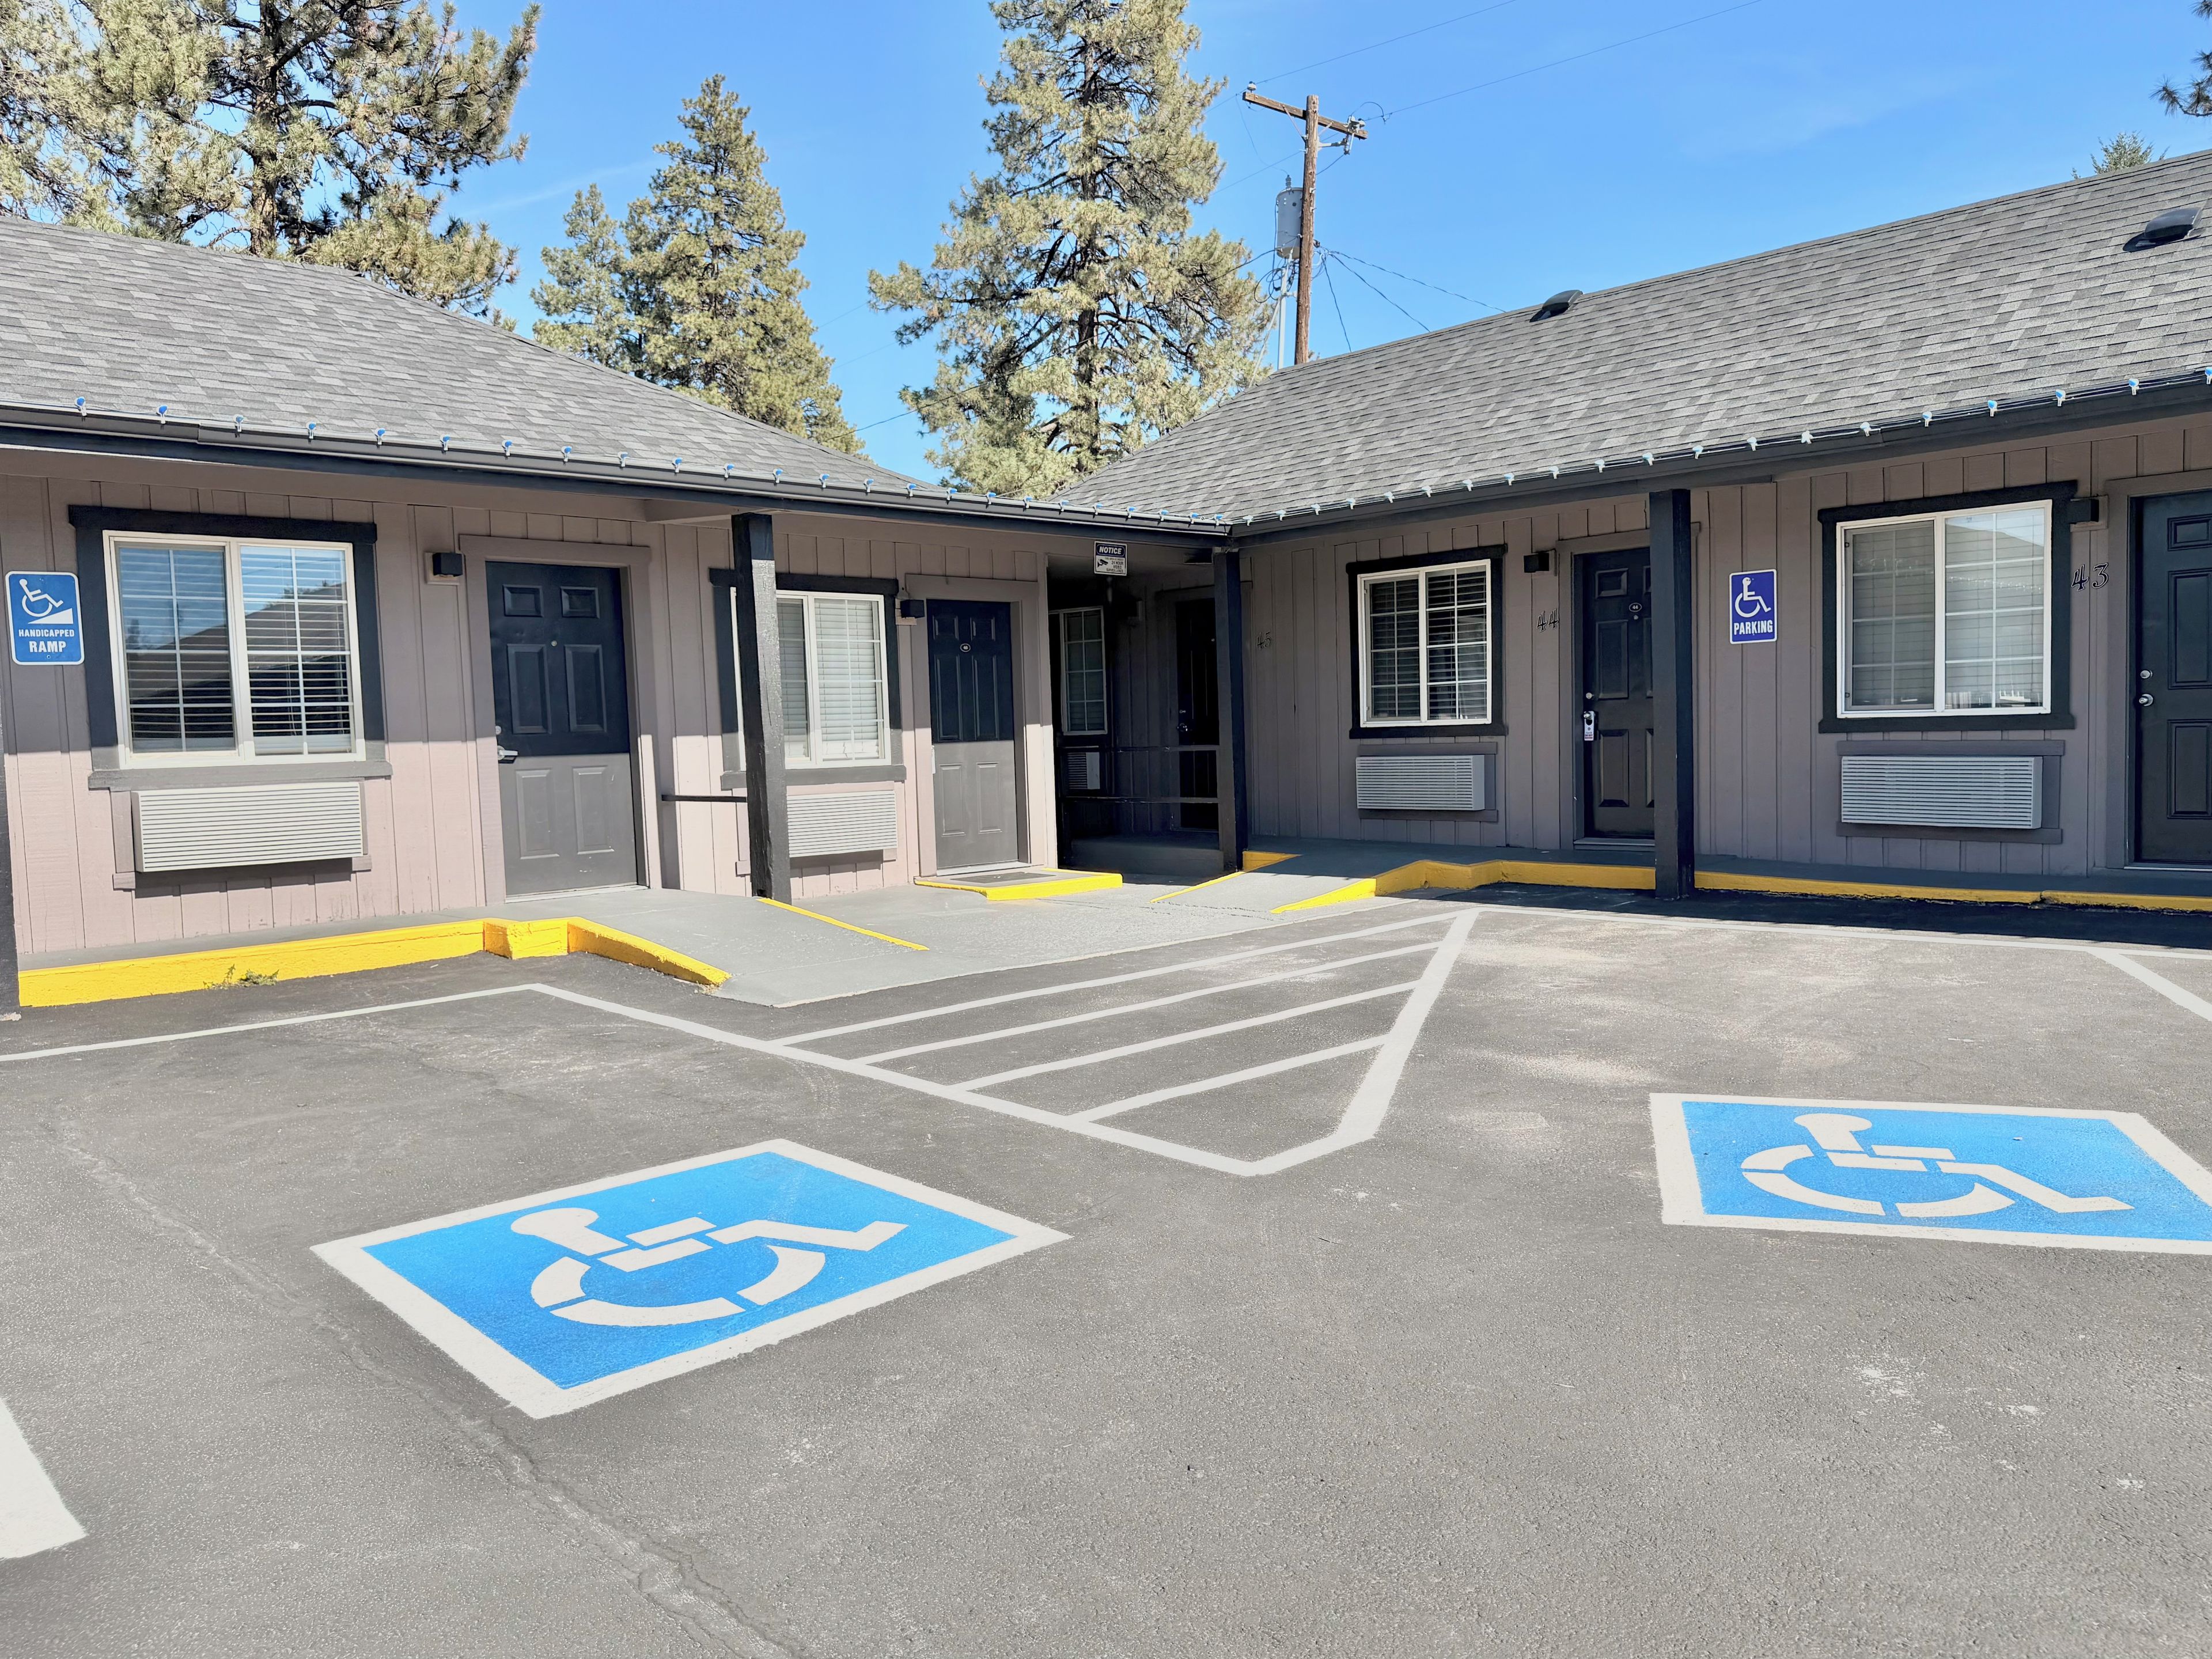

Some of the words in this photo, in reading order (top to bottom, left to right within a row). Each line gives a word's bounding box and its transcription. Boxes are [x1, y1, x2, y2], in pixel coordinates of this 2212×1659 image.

[1099, 546, 1122, 554] NOTICE
[2071, 562, 2108, 592] 43
[1536, 608, 1559, 632] 44
[1734, 620, 1773, 635] PARKING
[18, 629, 75, 637] HANDICAPPED
[1256, 631, 1271, 649] 45
[29, 641, 66, 653] RAMP
